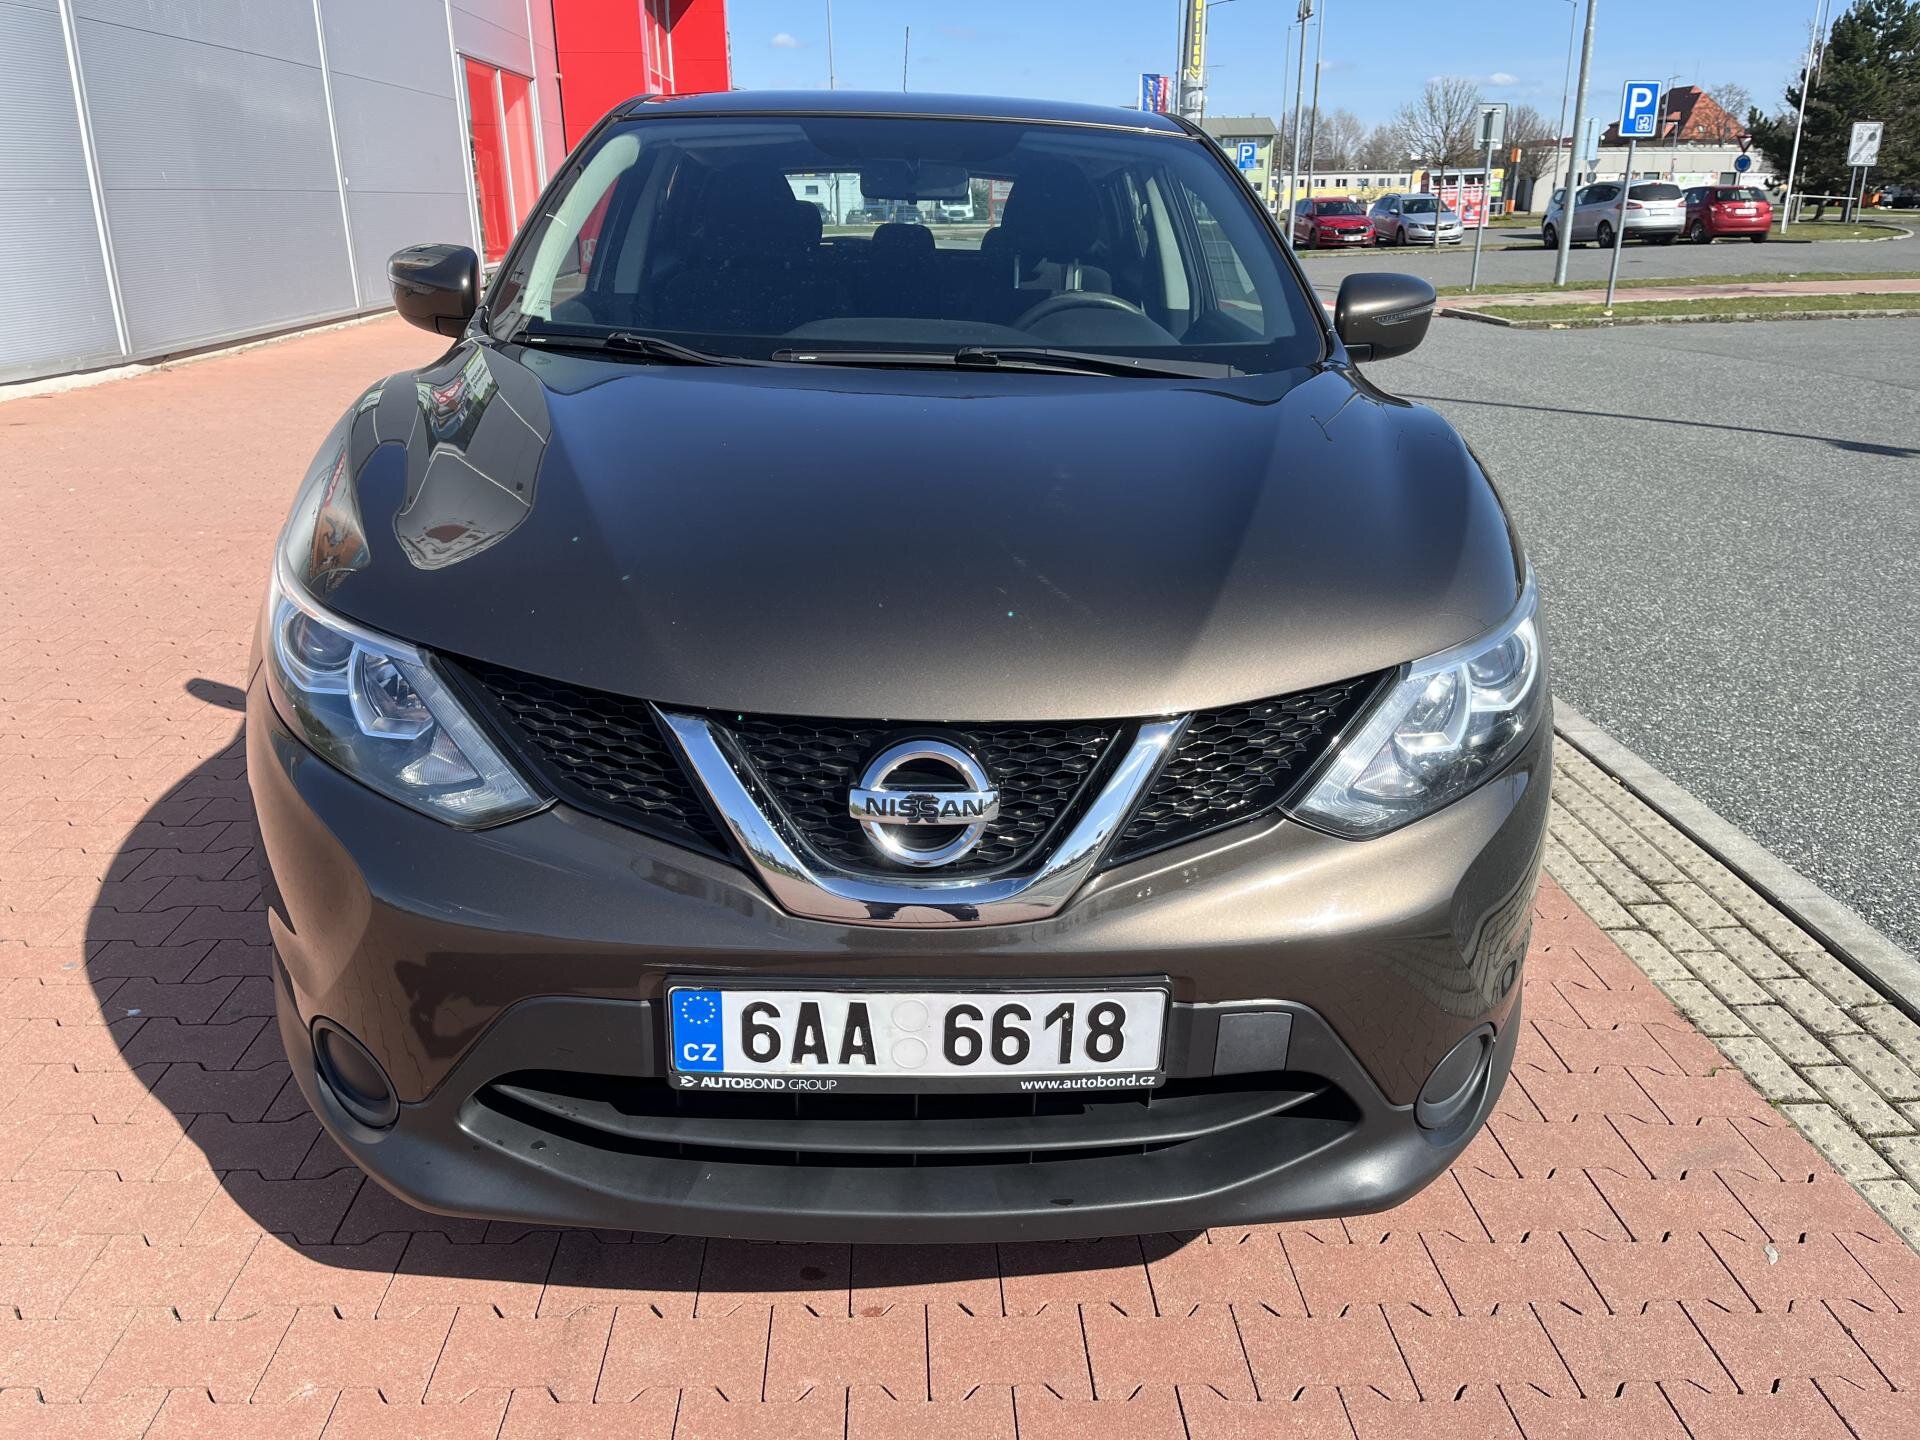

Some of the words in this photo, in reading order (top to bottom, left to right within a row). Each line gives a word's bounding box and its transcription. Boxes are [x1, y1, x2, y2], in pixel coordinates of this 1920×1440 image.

[1628, 87, 1653, 120] P
[1241, 146, 1253, 162] P
[865, 797, 984, 817] NISSAN
[741, 1001, 877, 1065] 6AA
[943, 1001, 1127, 1065] 6618
[682, 1043, 717, 1062] CZ
[700, 1076, 786, 1090] AUTOBOND
[788, 1078, 838, 1091] GROUP
[1020, 1073, 1156, 1090] www.autobond.cz
